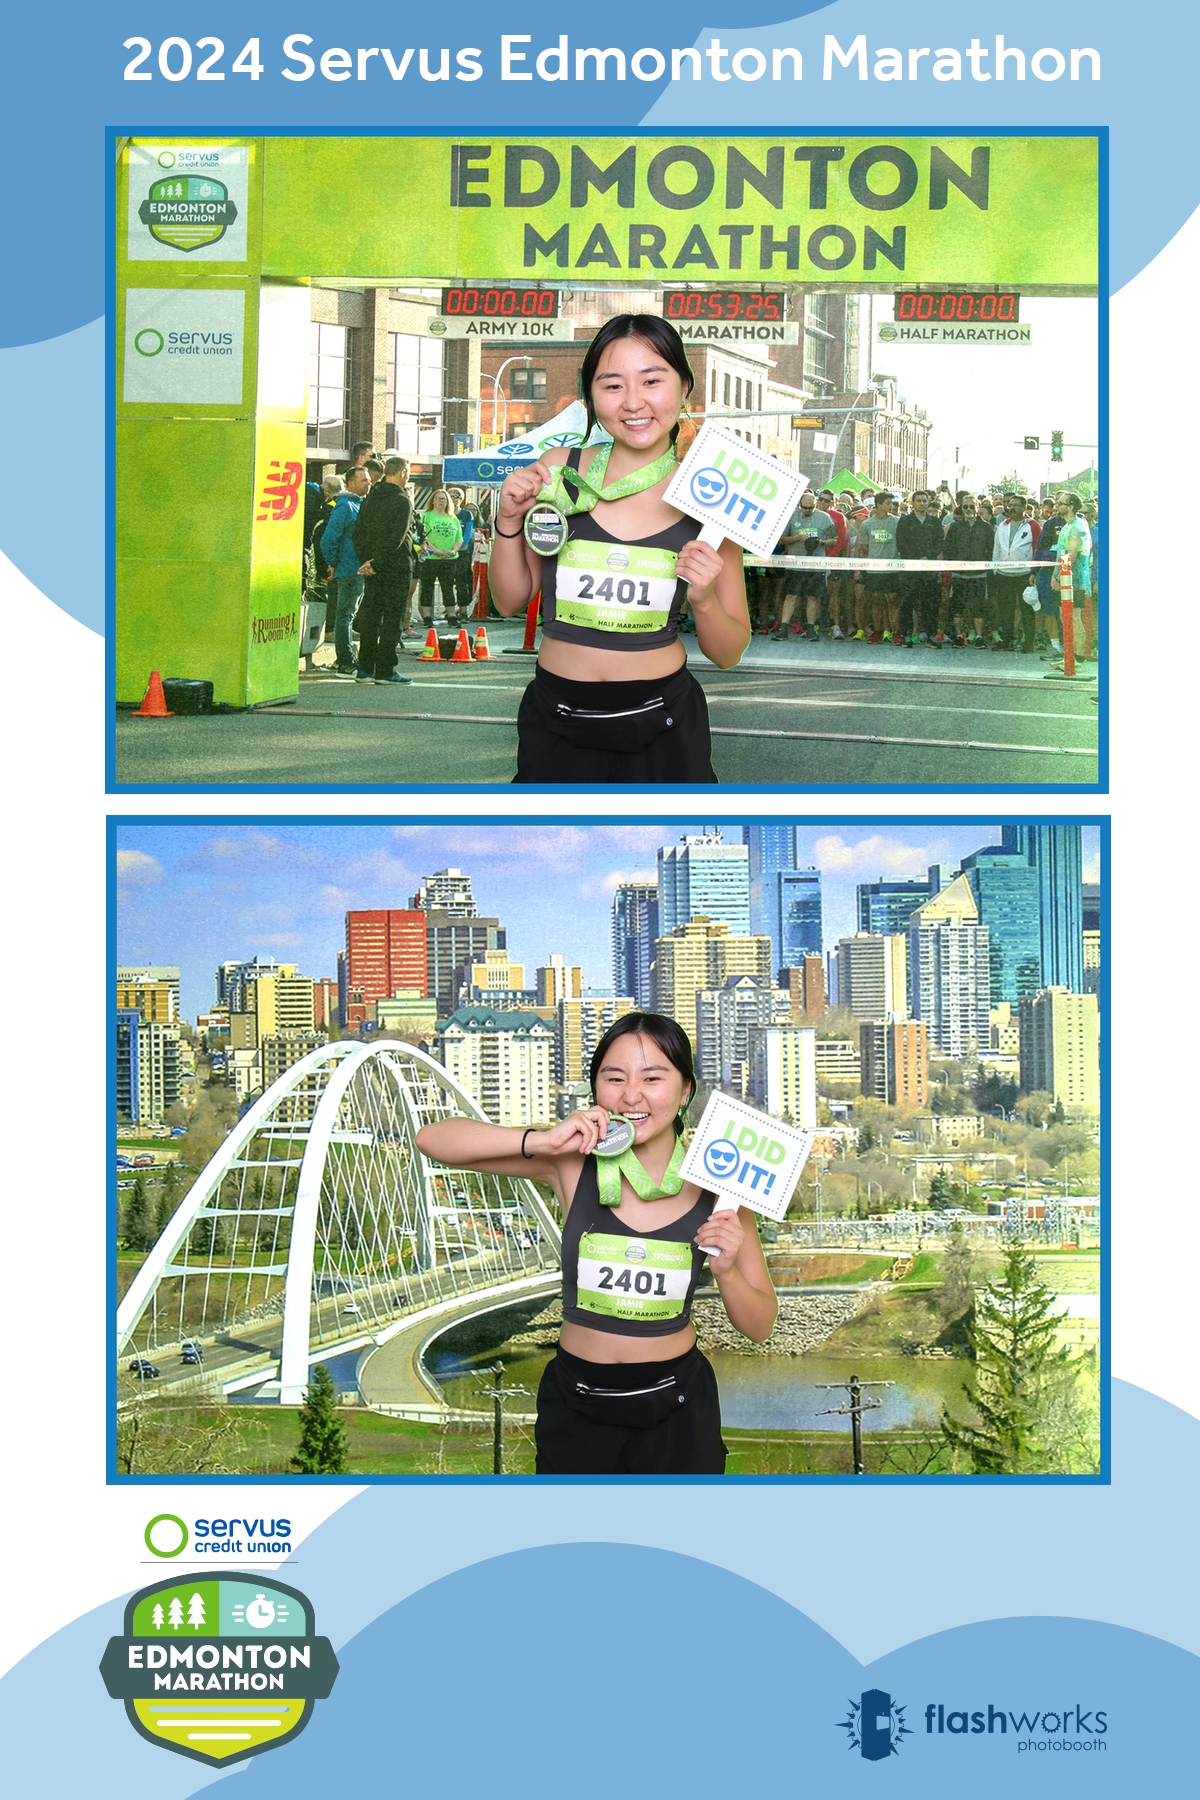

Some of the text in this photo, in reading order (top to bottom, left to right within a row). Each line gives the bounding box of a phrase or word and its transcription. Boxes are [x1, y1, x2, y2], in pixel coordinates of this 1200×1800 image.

[178, 152, 220, 161] servus
[449, 143, 990, 212] EDMONTON
[149, 202, 227, 214] EDMONTON
[160, 214, 215, 222] MARATHON
[522, 223, 907, 271] MARATHON
[465, 321, 554, 337] ARMY 10K
[680, 325, 785, 340] MARATHON
[900, 328, 1031, 341] HALF MARATHON
[168, 331, 233, 345] servus
[168, 343, 233, 355] credit union
[712, 449, 778, 501] I DID
[723, 492, 766, 531] IT!
[577, 574, 651, 606] 2401
[596, 608, 627, 620] JAMIE
[598, 620, 615, 628] HALF
[723, 1120, 786, 1165] I DID
[737, 1161, 776, 1196] IT!
[597, 1266, 667, 1296] 2401
[615, 1298, 644, 1308] JAMIE
